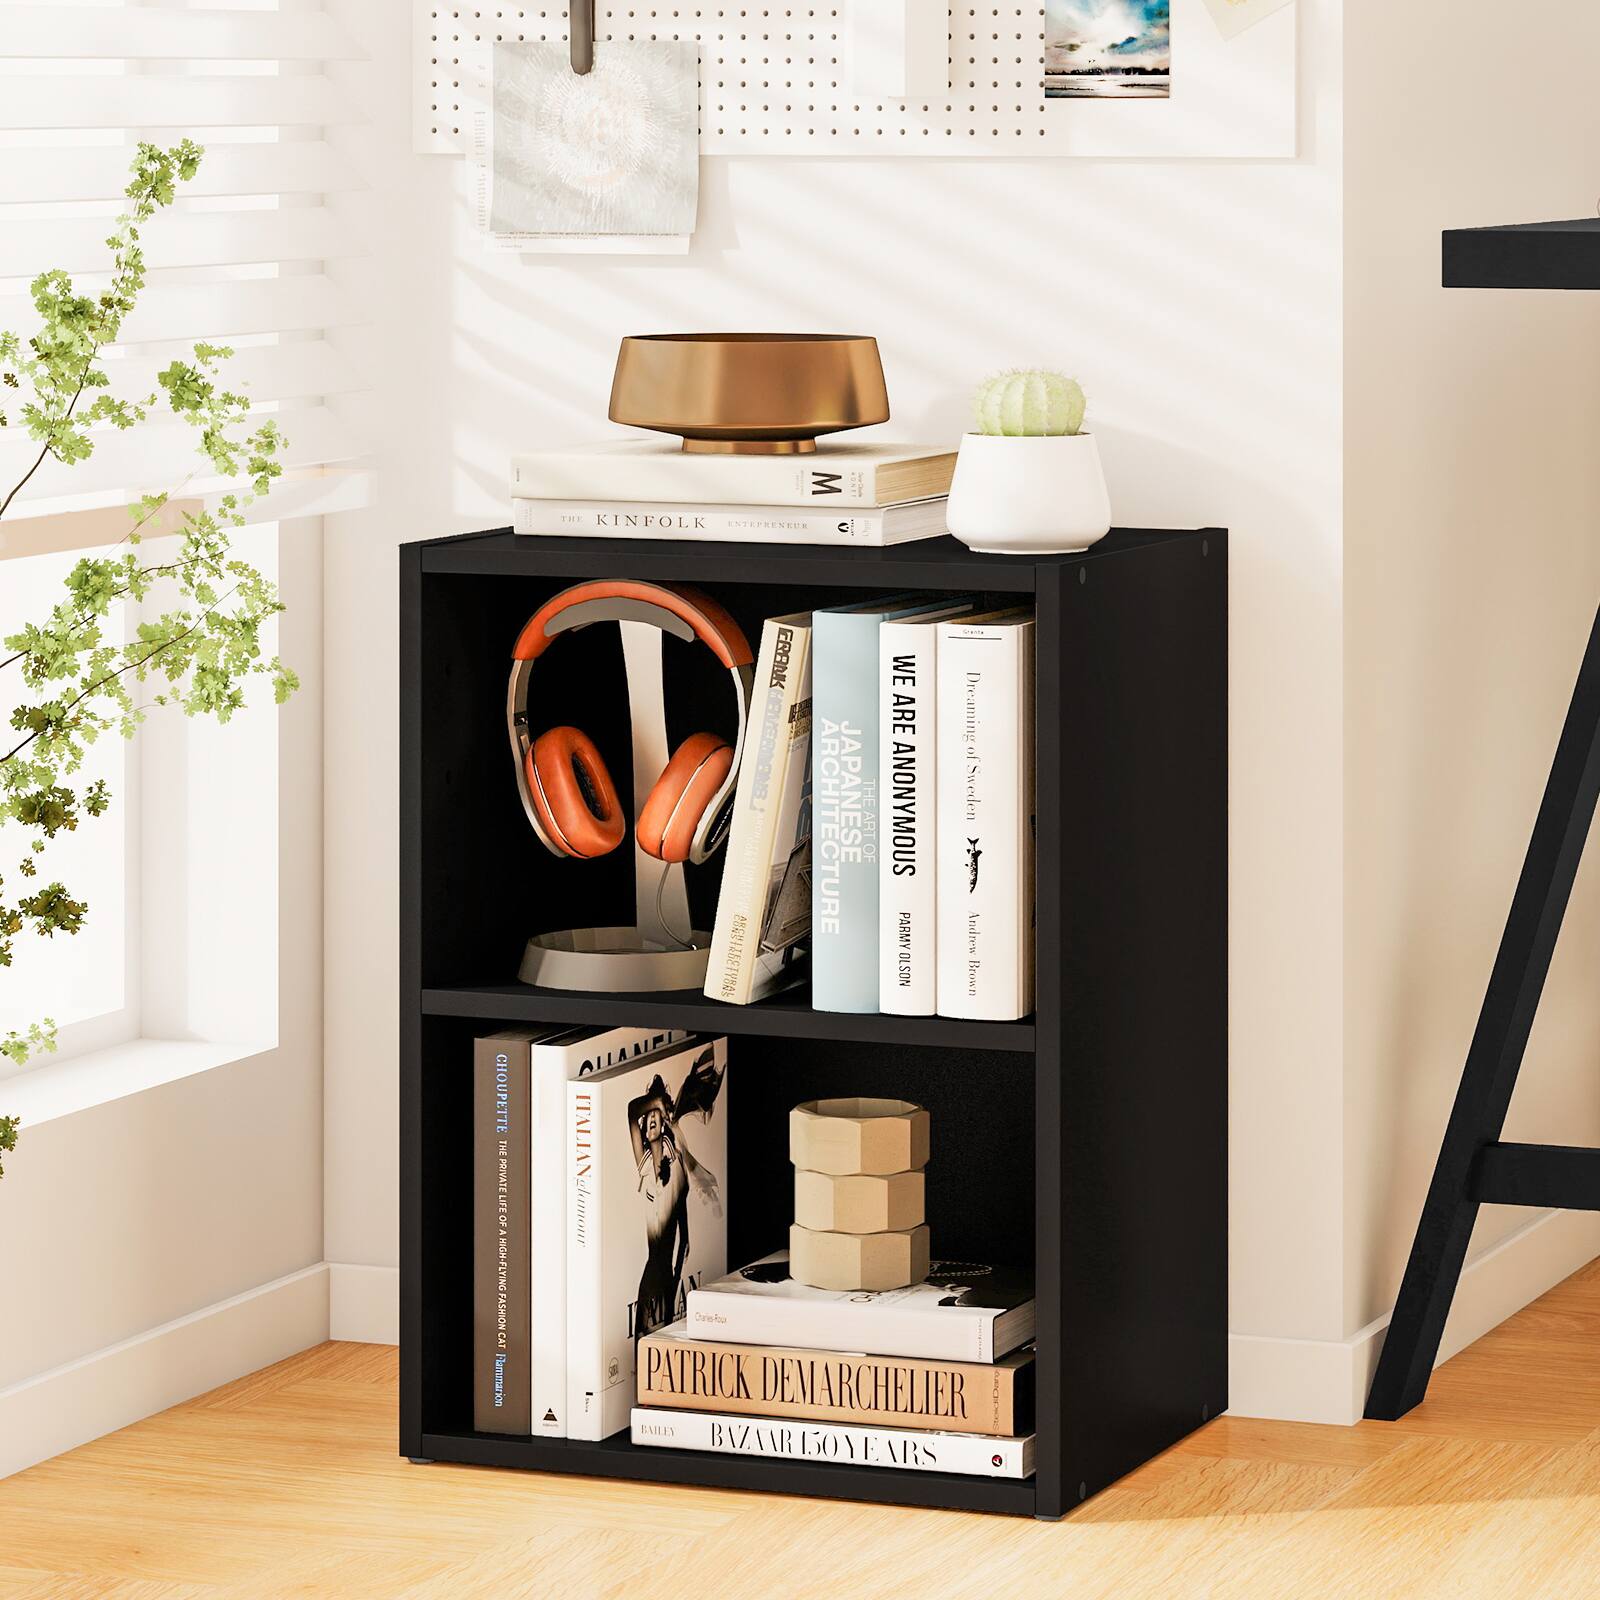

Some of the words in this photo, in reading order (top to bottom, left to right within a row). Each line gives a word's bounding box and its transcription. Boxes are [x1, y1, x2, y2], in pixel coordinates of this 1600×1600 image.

[811, 472, 842, 495] M
[560, 515, 584, 523] THE
[596, 513, 706, 529] KINFOLK
[769, 627, 793, 689] FRANK
[892, 654, 916, 687] WE
[892, 693, 916, 735] ARE
[962, 671, 981, 742] Dreaming
[965, 745, 981, 760] of
[840, 720, 862, 864] JAPANESE
[863, 779, 876, 806] THE
[892, 740, 916, 877] ANONYMOUS
[965, 762, 981, 821] Sweden
[821, 717, 840, 935] ARCHITECTURE
[863, 810, 876, 840] ART
[863, 844, 876, 864] OF
[899, 911, 911, 948] PARMY
[966, 910, 981, 955] Andrew
[720, 914, 741, 998] CONSTRUCTIONS
[725, 914, 748, 998] ARCHITECTURAL
[899, 952, 911, 987] OLSON
[966, 959, 981, 997] Brown
[495, 1053, 508, 1133] CHOUPETTE
[498, 1140, 507, 1156] THE
[576, 1094, 592, 1177] ITALIAN
[498, 1158, 507, 1193] PRIVATE
[498, 1195, 507, 1213] LIFE
[498, 1215, 507, 1228] OF
[574, 1178, 592, 1248] glamour
[498, 1293, 507, 1330] FASHION
[498, 1332, 507, 1349] CAT
[494, 1353, 506, 1407] Flammarion
[646, 1346, 753, 1400] PATRICK
[760, 1356, 968, 1419] DEMARCHELIER
[640, 1424, 677, 1437] BAILEY
[711, 1422, 793, 1454] BAZAAR
[800, 1431, 839, 1459] 150
[838, 1434, 938, 1466] YEARS
